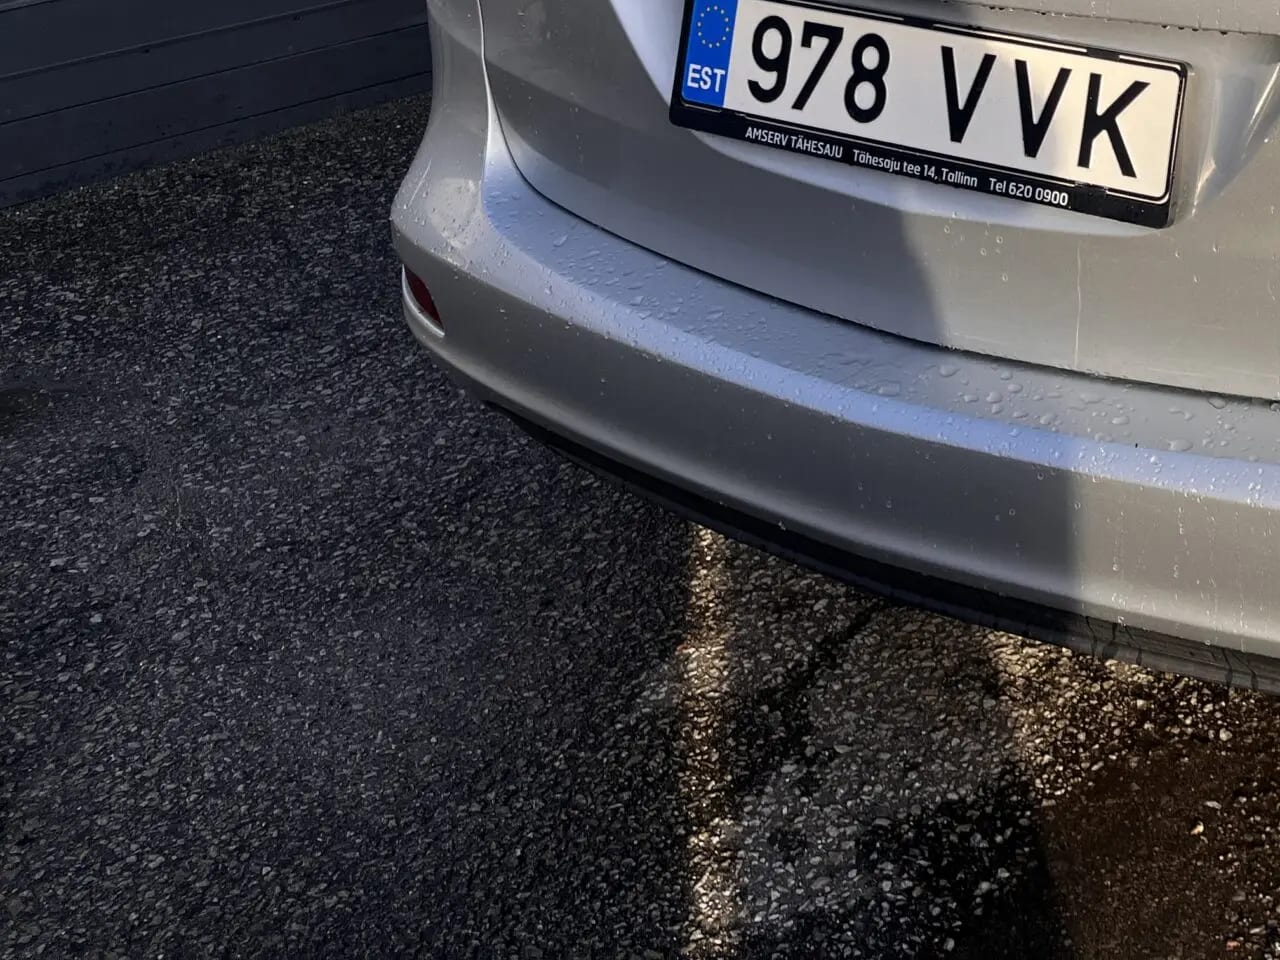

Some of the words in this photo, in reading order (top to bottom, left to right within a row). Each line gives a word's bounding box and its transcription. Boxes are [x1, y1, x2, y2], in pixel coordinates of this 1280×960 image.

[686, 64, 726, 93] EST
[747, 14, 891, 124] 978
[940, 44, 1151, 179] VVK
[745, 126, 789, 146] AMSERV
[790, 135, 844, 159] TÄHESAJU
[852, 149, 901, 173] Tähesaju
[902, 160, 921, 175] tee
[923, 164, 938, 180] 14,
[941, 167, 978, 188] Tallinn
[988, 177, 1007, 193] Tel
[1008, 182, 1033, 199] 620
[1034, 187, 1069, 206] 0900
